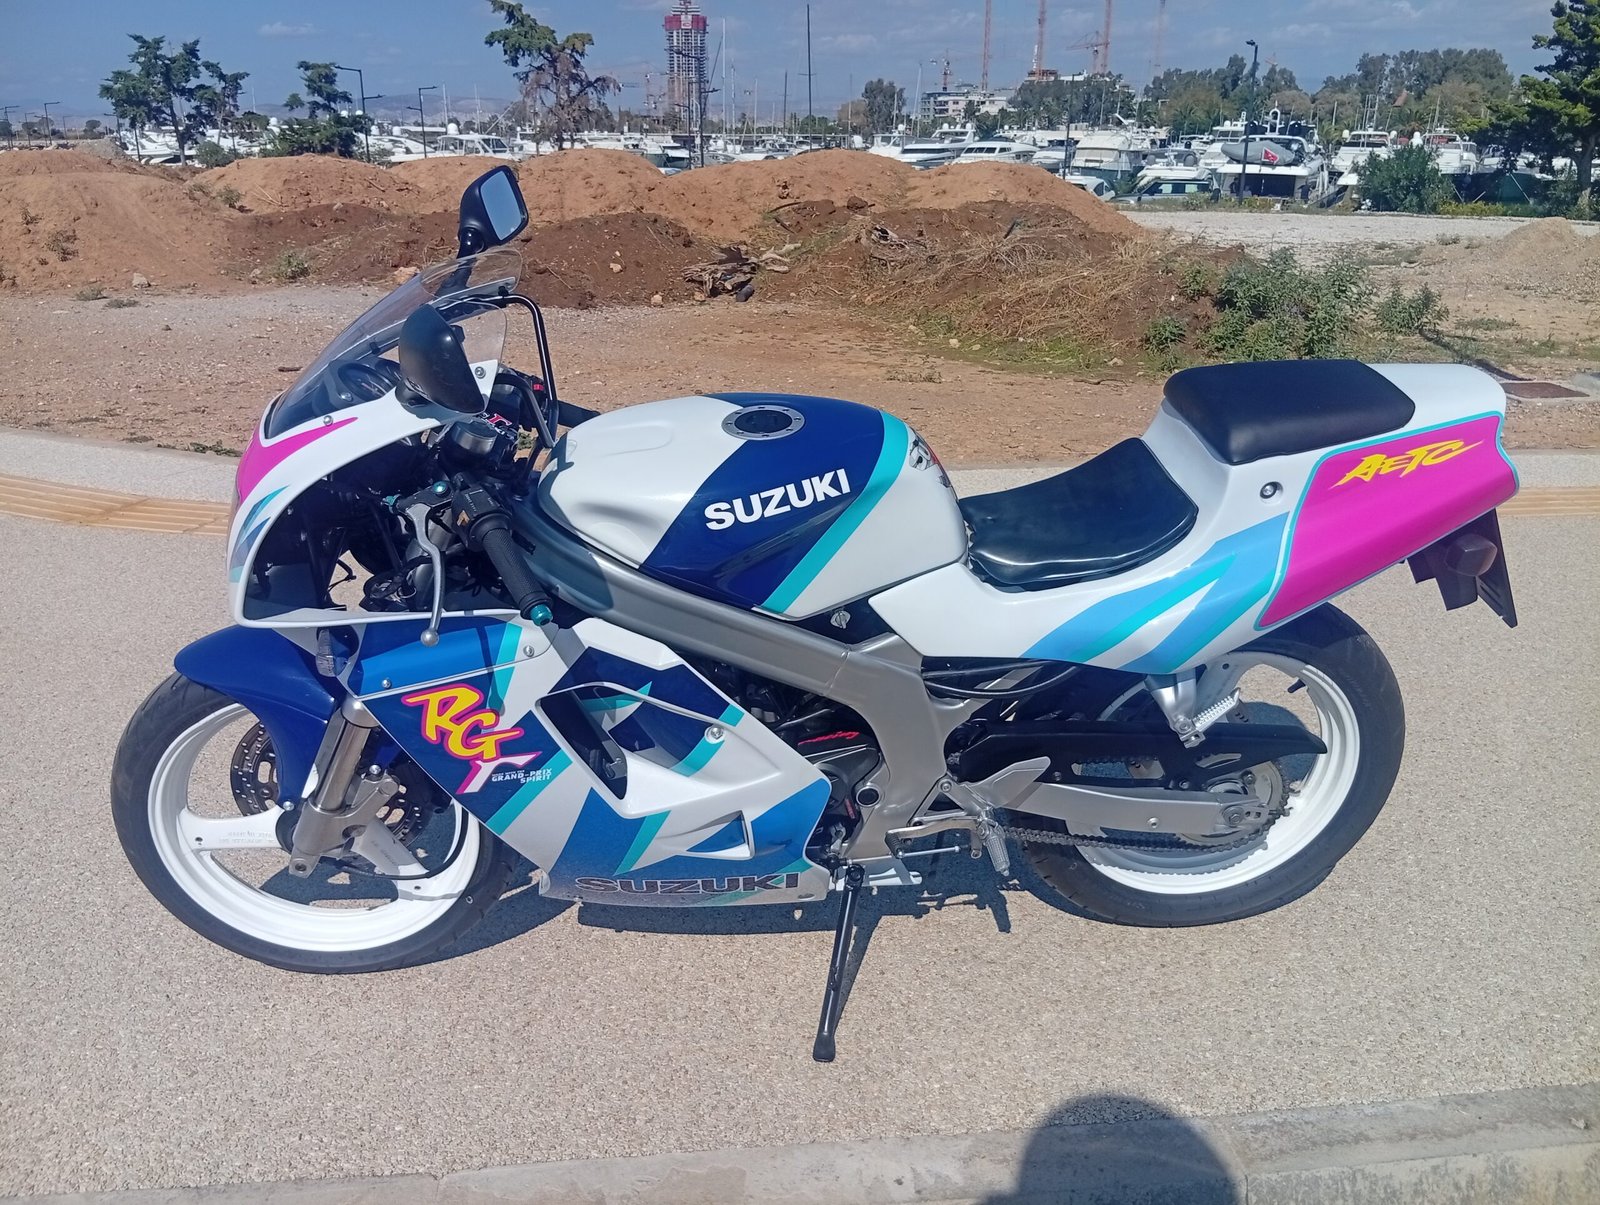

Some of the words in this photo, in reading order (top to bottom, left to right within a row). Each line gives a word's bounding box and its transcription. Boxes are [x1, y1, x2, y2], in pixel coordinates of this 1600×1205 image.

[704, 468, 851, 531] SUZUKI
[520, 774, 552, 784] SPIRIT
[575, 872, 801, 895] SUZUKI
